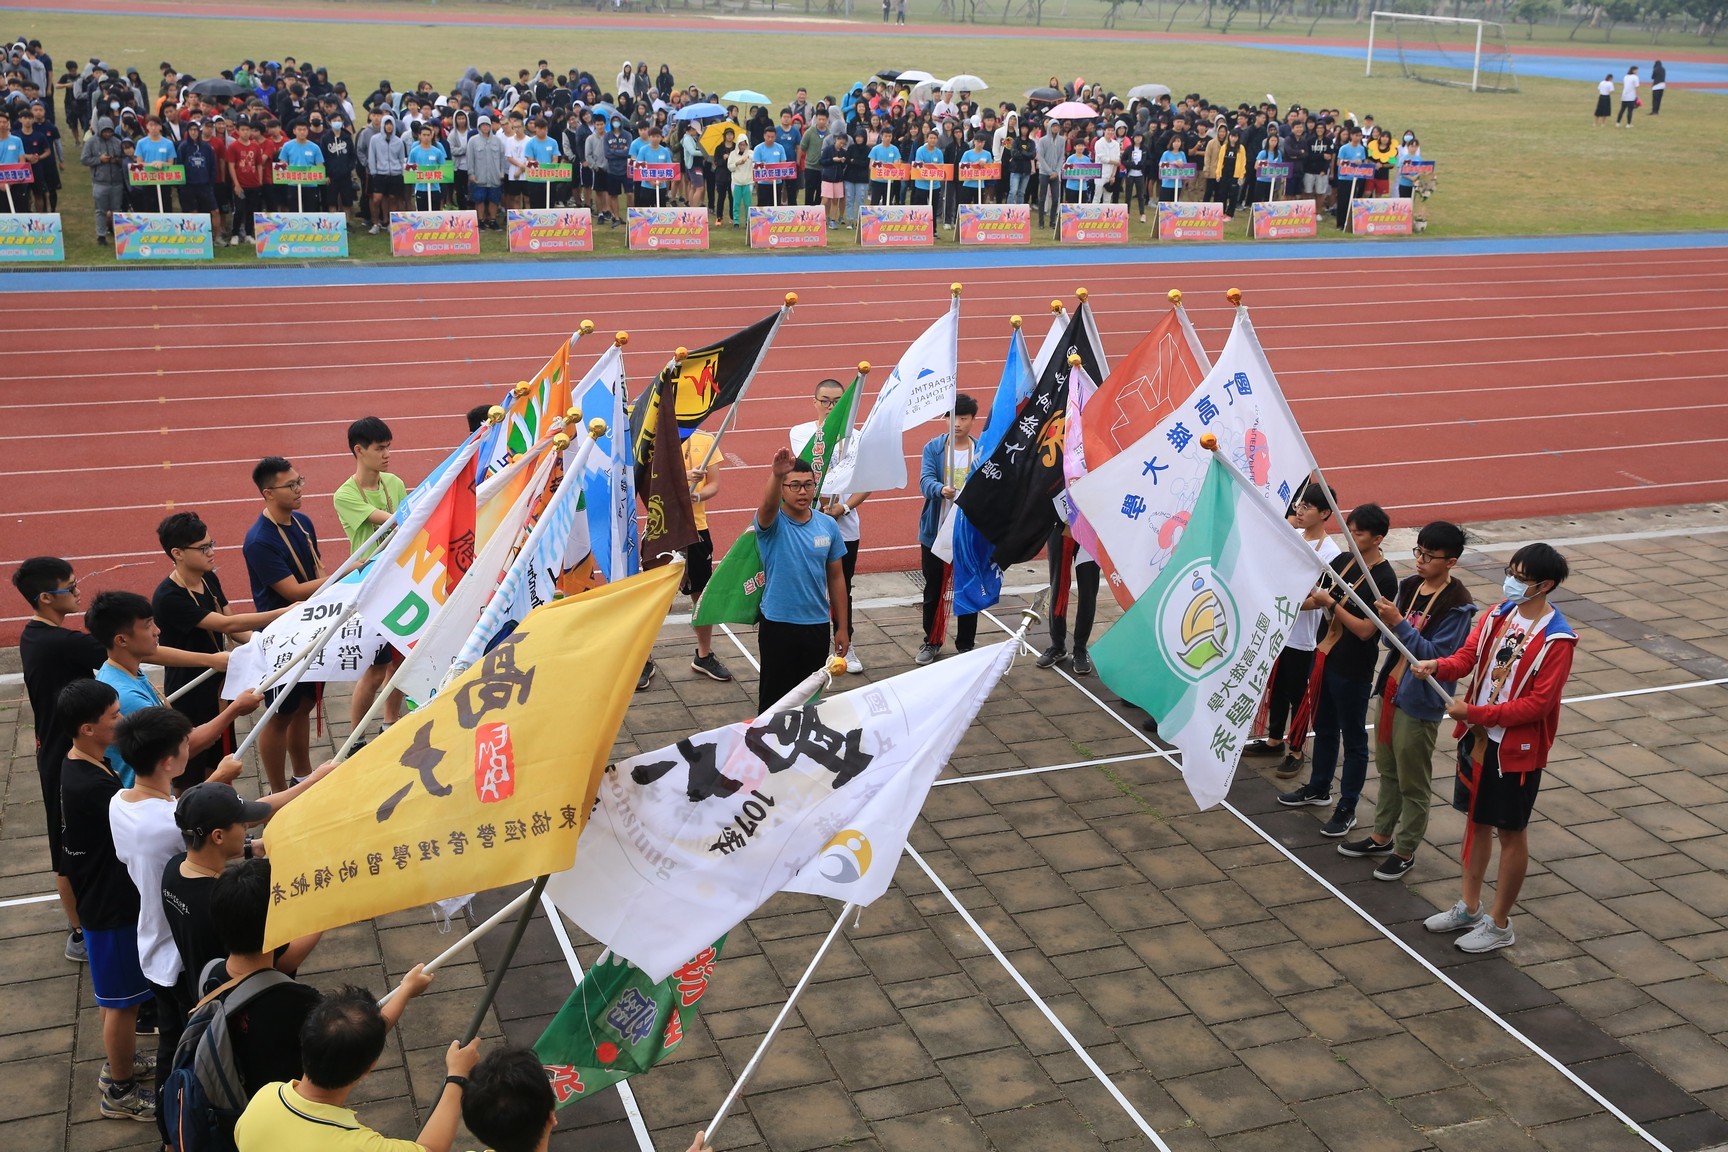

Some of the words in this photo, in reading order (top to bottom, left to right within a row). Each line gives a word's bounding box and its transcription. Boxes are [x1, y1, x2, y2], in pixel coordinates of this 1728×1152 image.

[132, 171, 182, 181] 資訊工程學系
[416, 170, 443, 181] 工學院
[640, 168, 674, 179] 管理學院
[753, 167, 795, 178] 資訊管理學系
[876, 168, 906, 178] 法律學系
[921, 168, 945, 178] 法學院
[960, 167, 1000, 178] 財經法律學系
[529, 228, 587, 238] 校慶暨運動大會
[648, 226, 704, 235] 校慶暨運動大會
